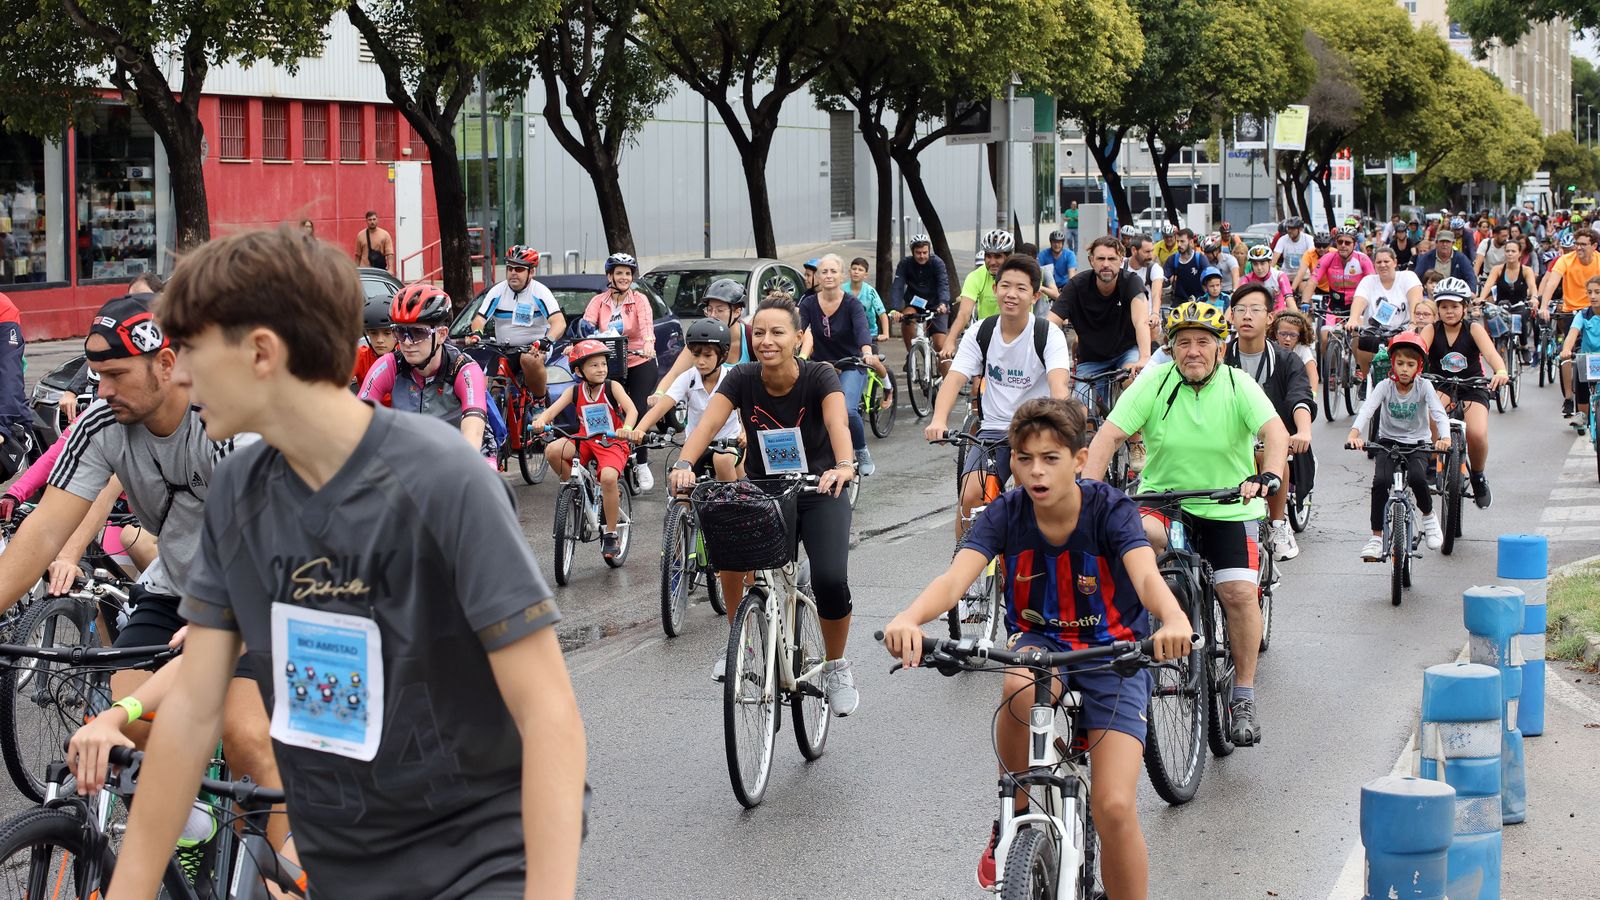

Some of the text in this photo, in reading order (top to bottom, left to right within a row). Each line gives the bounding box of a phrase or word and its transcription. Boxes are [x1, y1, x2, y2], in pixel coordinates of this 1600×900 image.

[1049, 614, 1101, 627] Spotify
[297, 637, 358, 655] BICI AMISTAD
